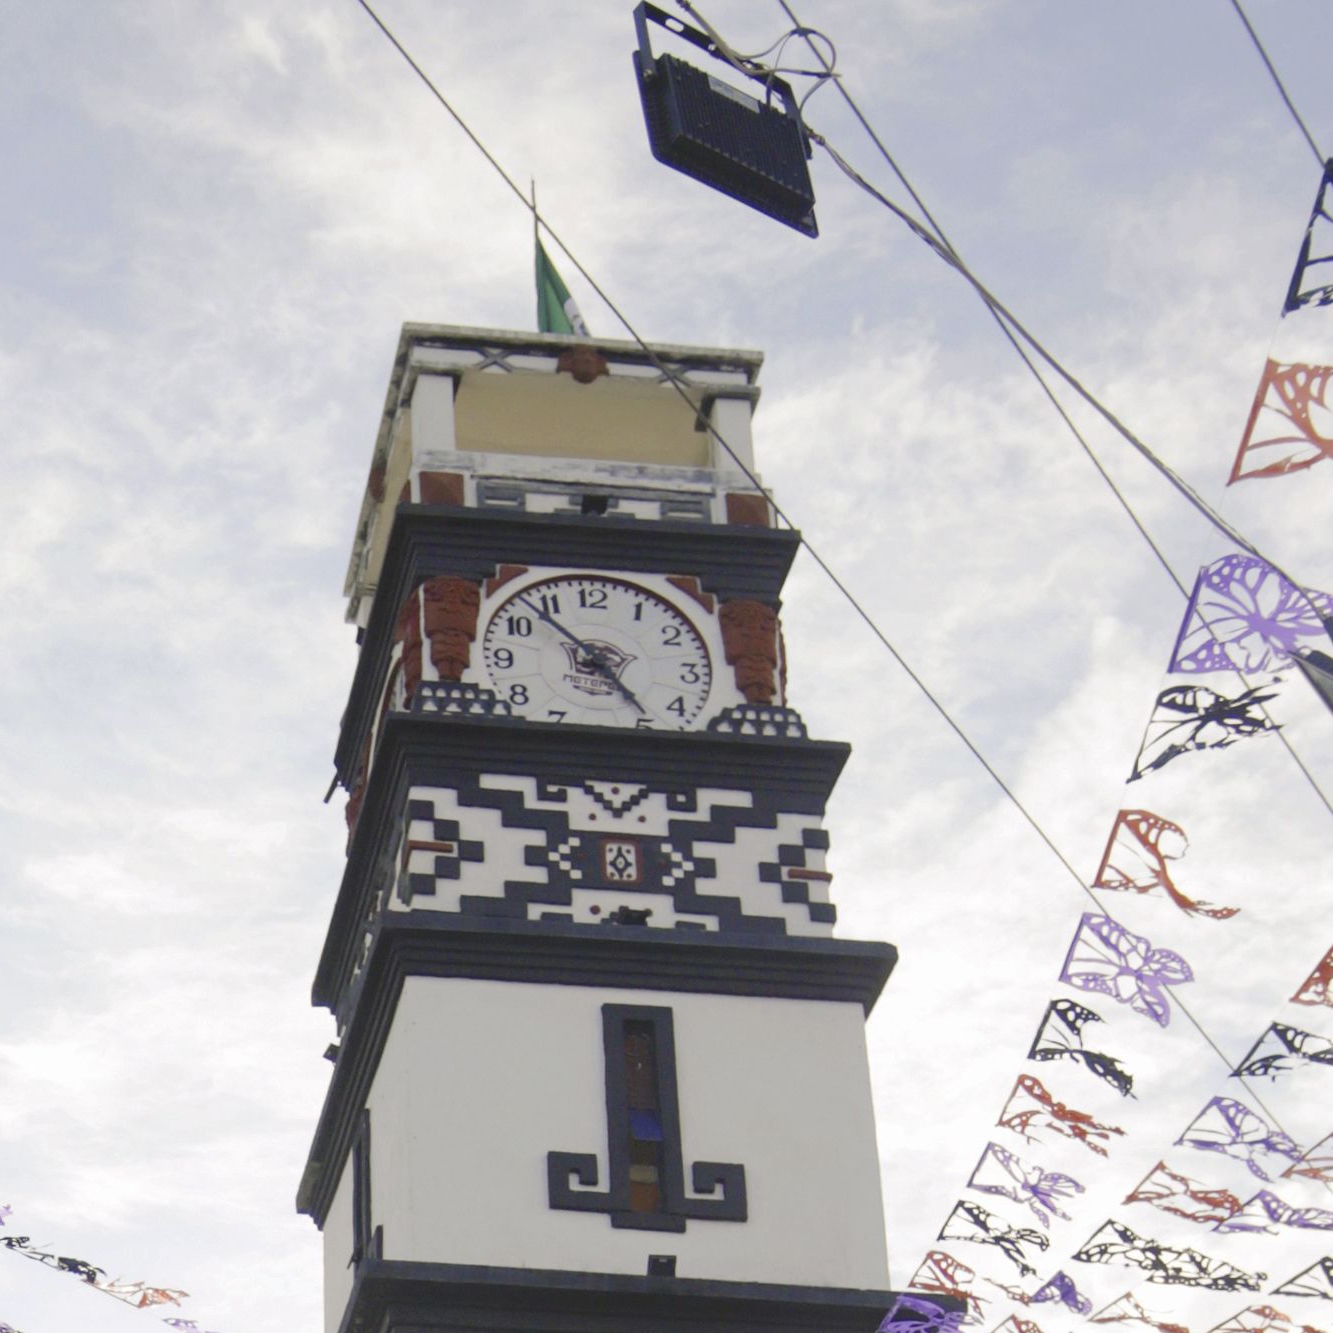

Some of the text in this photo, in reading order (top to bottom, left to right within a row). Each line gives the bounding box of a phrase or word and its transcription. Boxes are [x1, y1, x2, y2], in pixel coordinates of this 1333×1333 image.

[539, 594, 561, 615] 11
[578, 588, 608, 610] 12
[634, 602, 643, 621] 1
[506, 615, 532, 637] 10
[661, 625, 682, 646] 2
[493, 648, 514, 669] 9
[680, 662, 700, 684] 3
[509, 684, 529, 706] 8
[666, 696, 686, 717] 4
